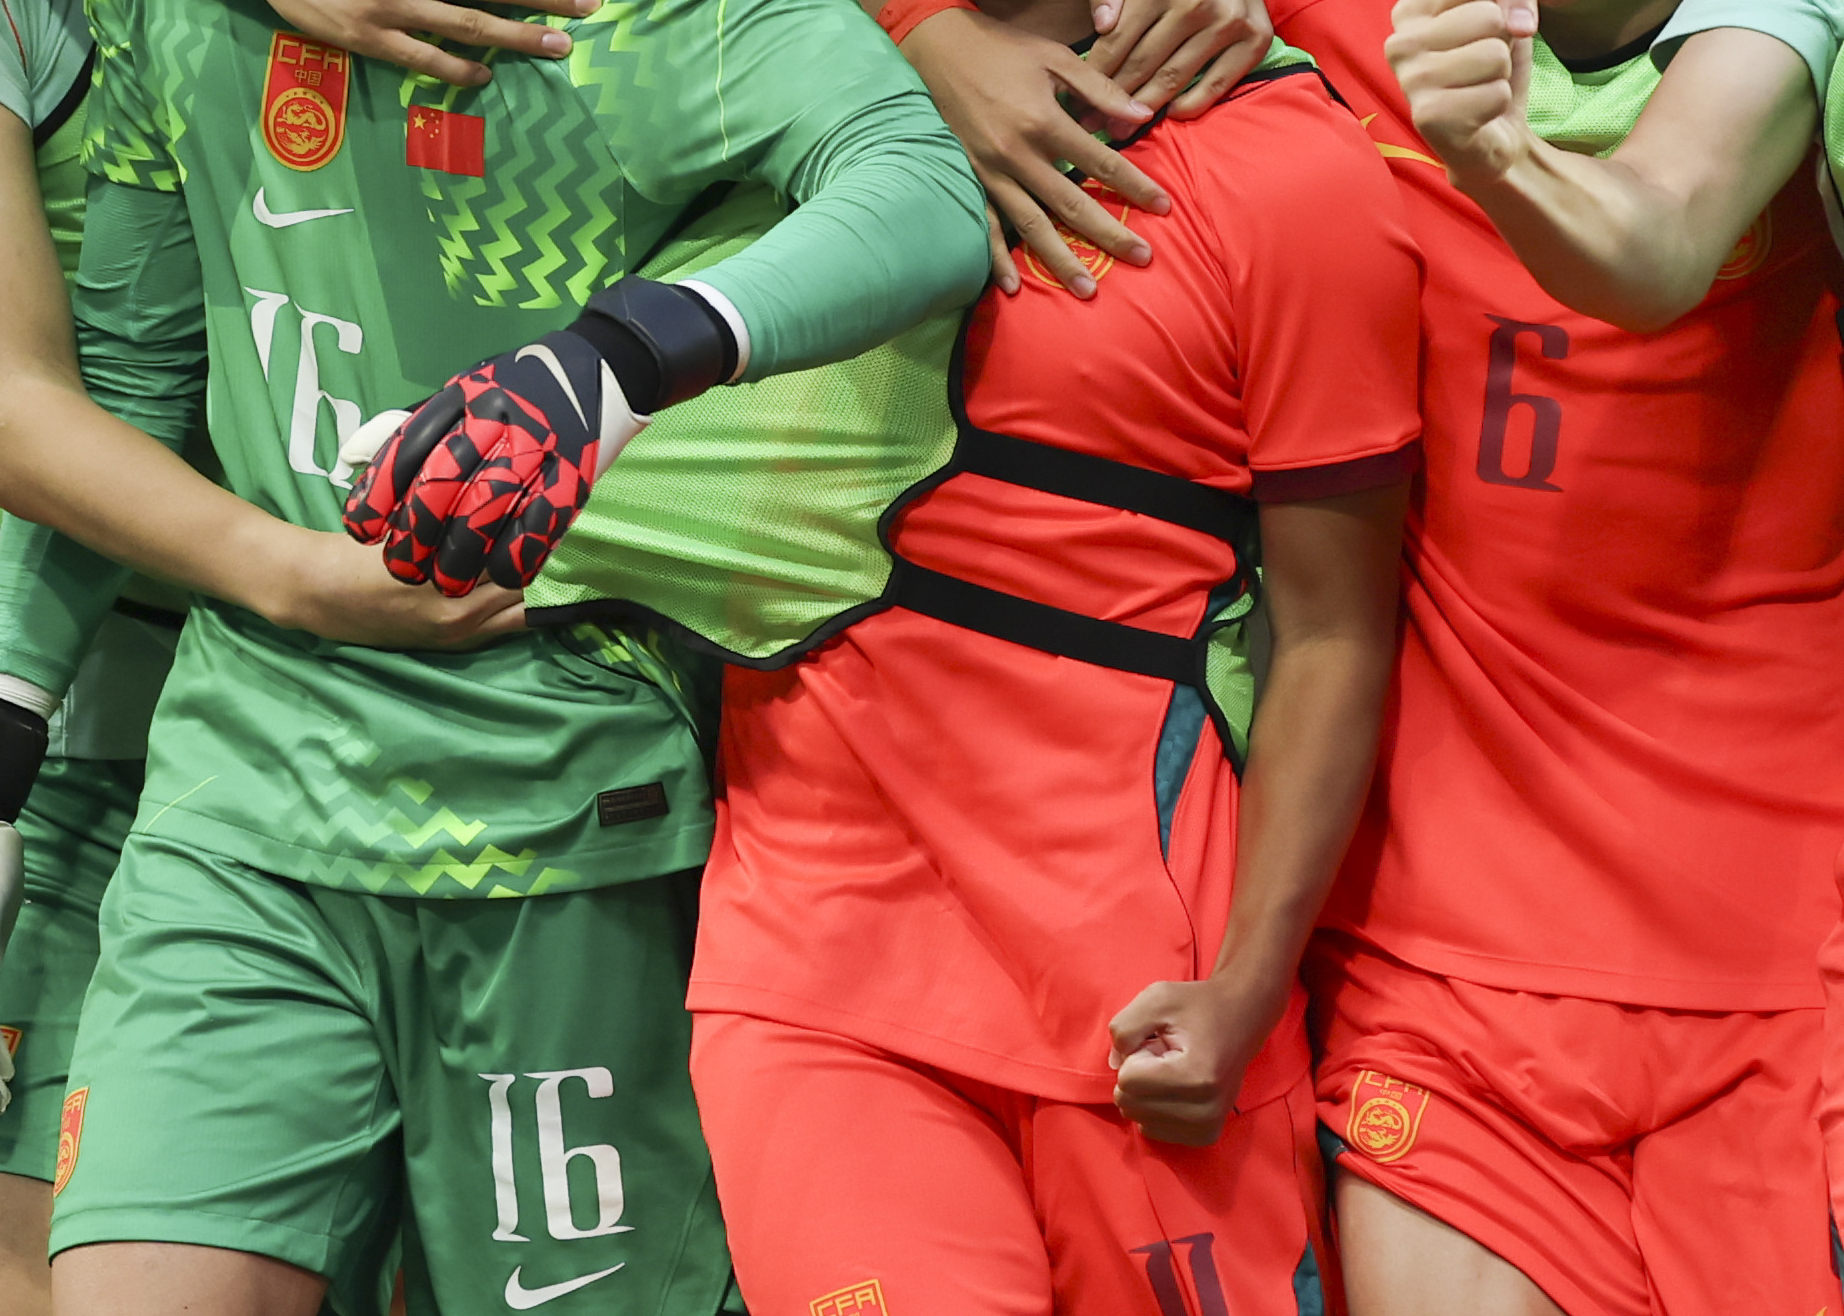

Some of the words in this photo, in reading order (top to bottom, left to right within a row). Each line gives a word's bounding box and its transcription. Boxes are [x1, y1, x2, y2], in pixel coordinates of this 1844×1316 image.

[277, 39, 344, 73] CFA
[295, 69, 322, 86] 中国
[243, 286, 363, 491] 16
[1476, 313, 1569, 493] 6
[478, 1066, 636, 1242] 16
